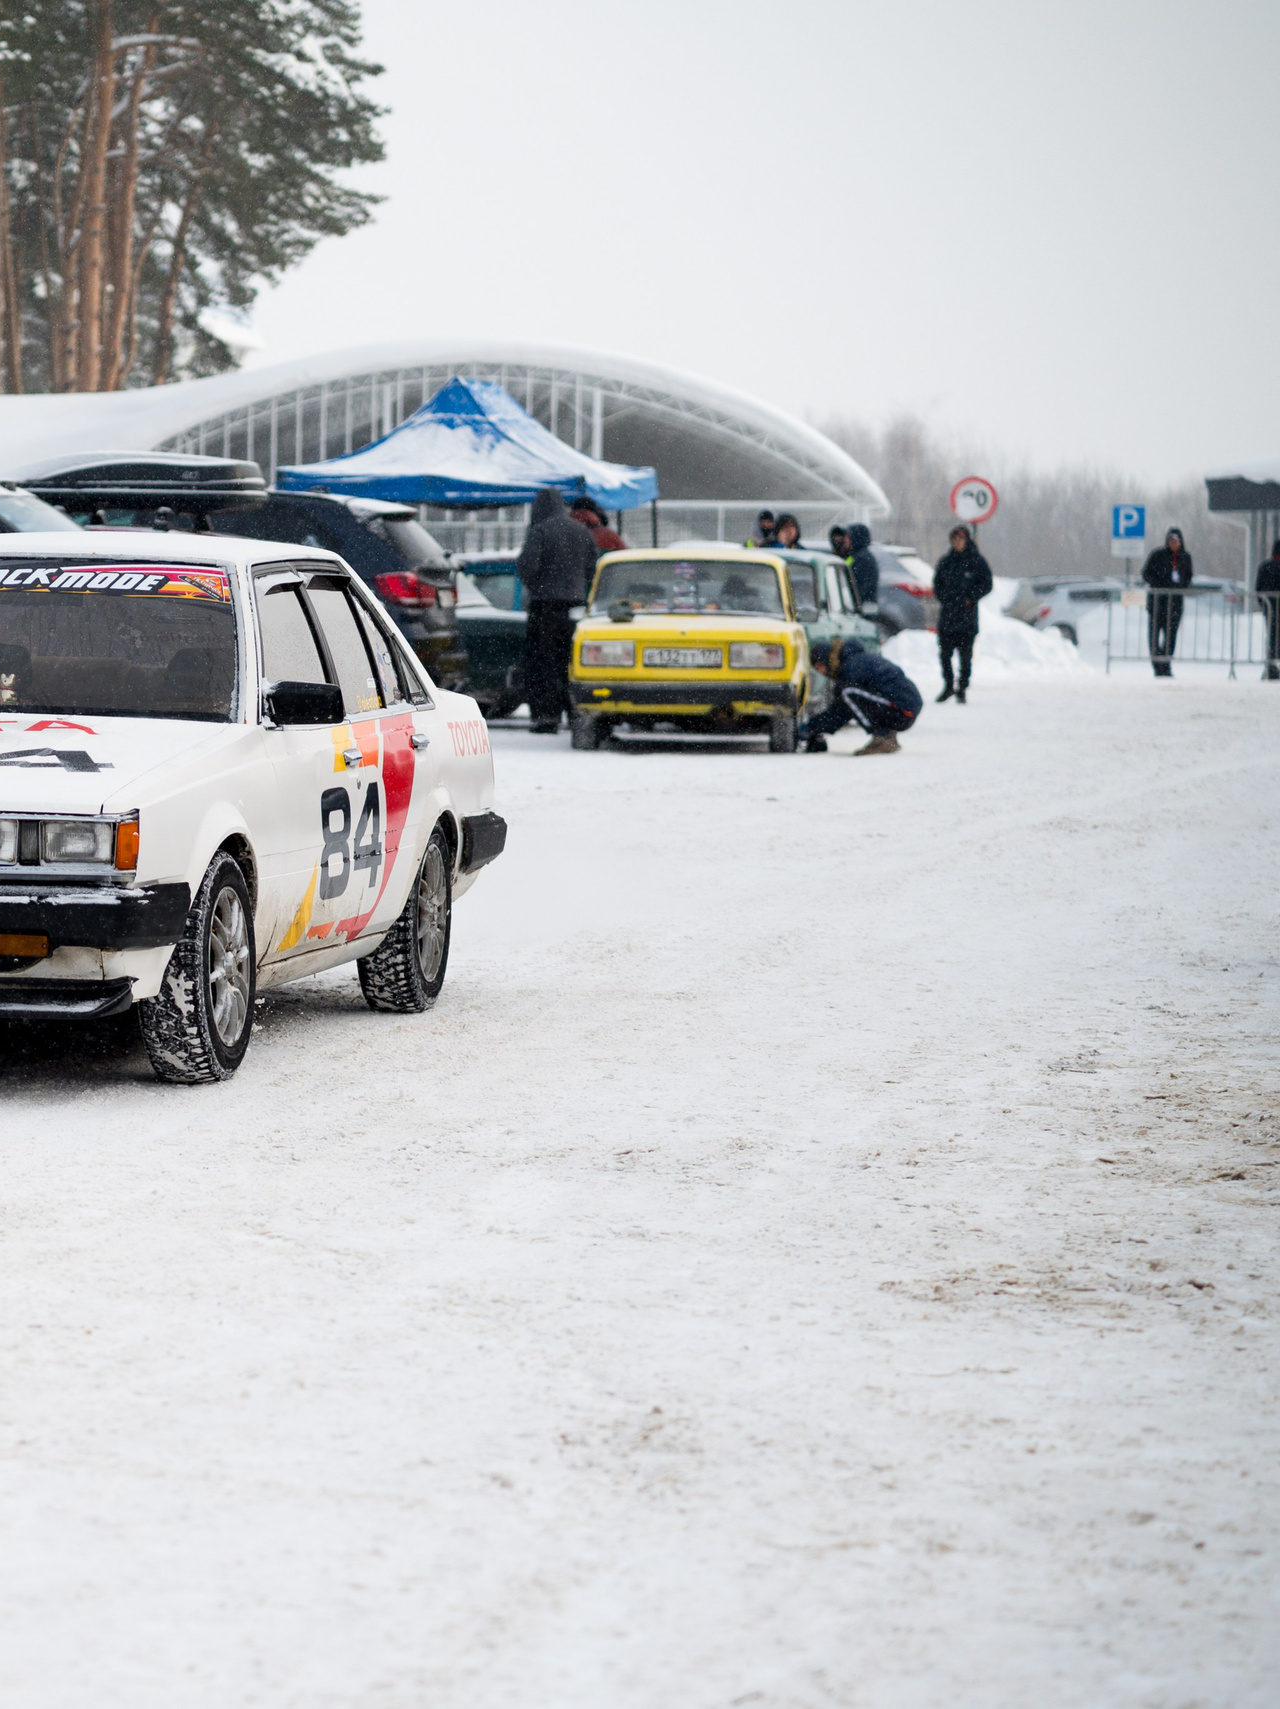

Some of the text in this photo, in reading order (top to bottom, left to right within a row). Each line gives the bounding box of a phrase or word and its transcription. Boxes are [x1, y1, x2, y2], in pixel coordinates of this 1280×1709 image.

[1120, 509, 1139, 535] P
[447, 720, 490, 757] TOYOTA
[319, 781, 382, 900] 84
